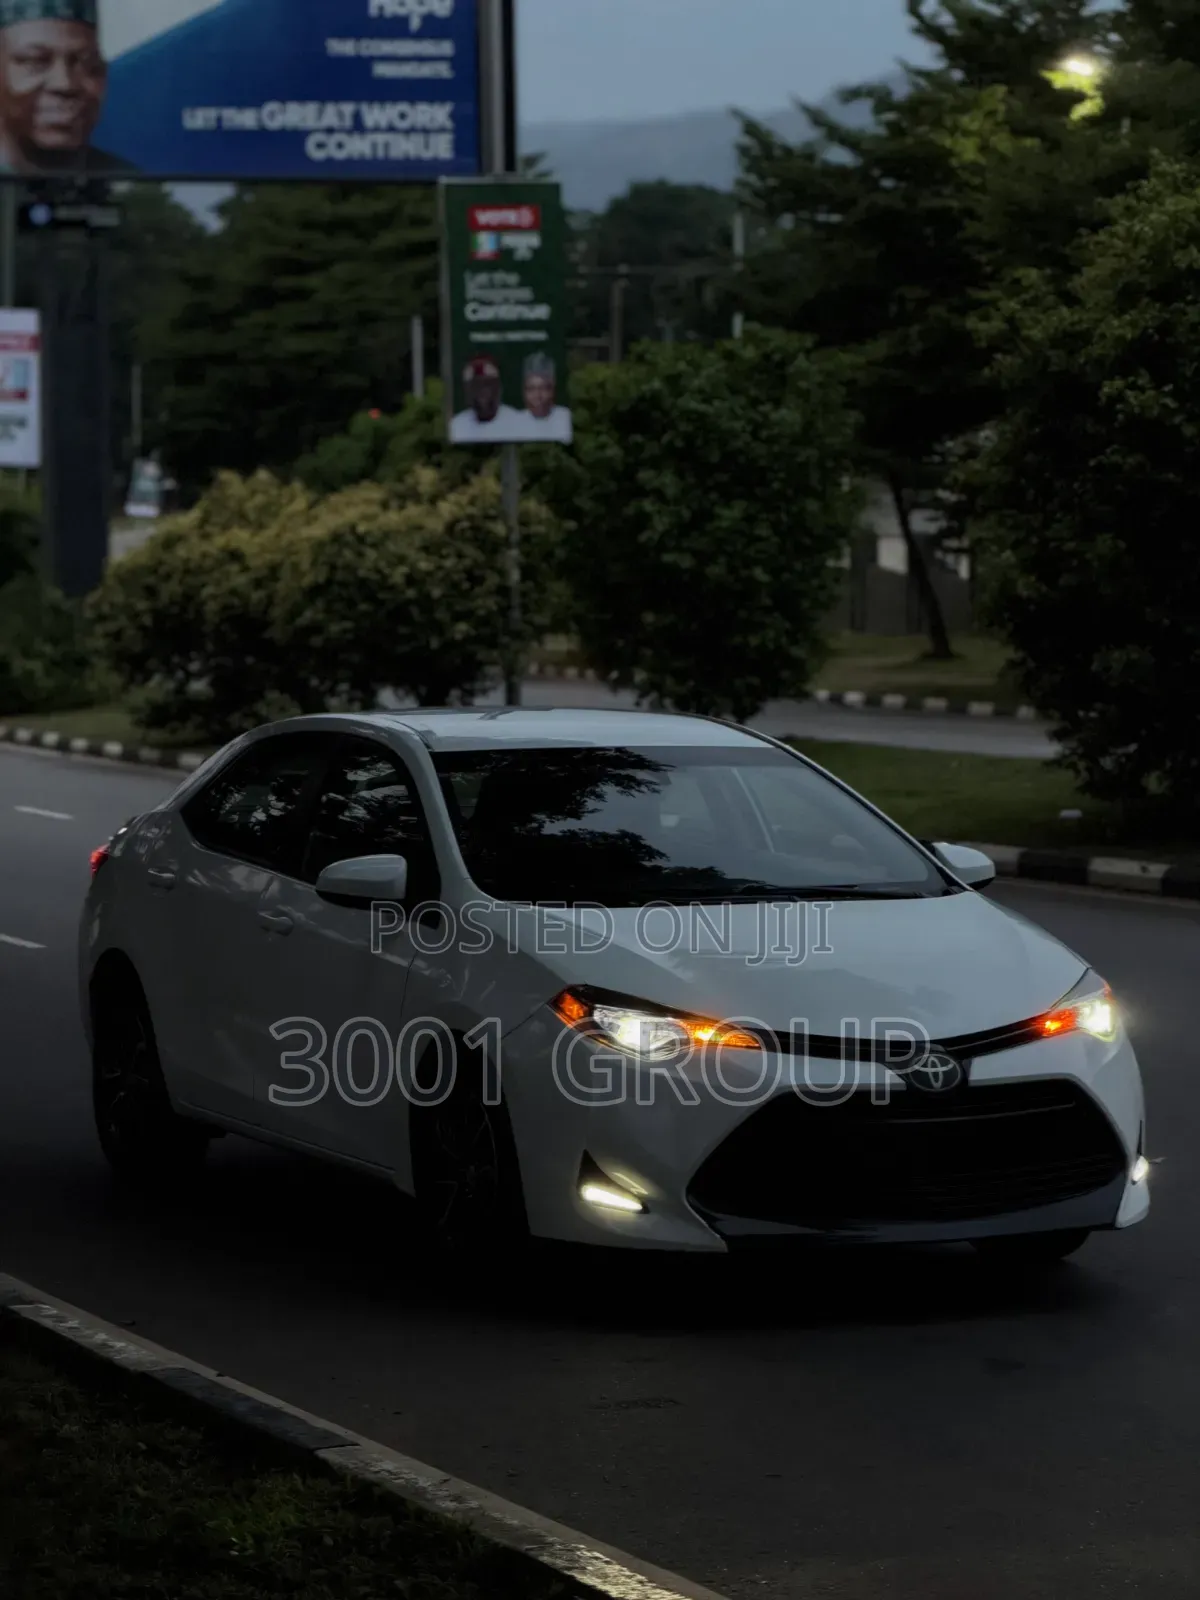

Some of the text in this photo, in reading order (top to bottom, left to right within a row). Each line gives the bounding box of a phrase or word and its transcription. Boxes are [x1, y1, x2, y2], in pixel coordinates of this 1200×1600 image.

[182, 102, 454, 129] LET THE GREAT WORK
[305, 132, 454, 159] CONTINUE
